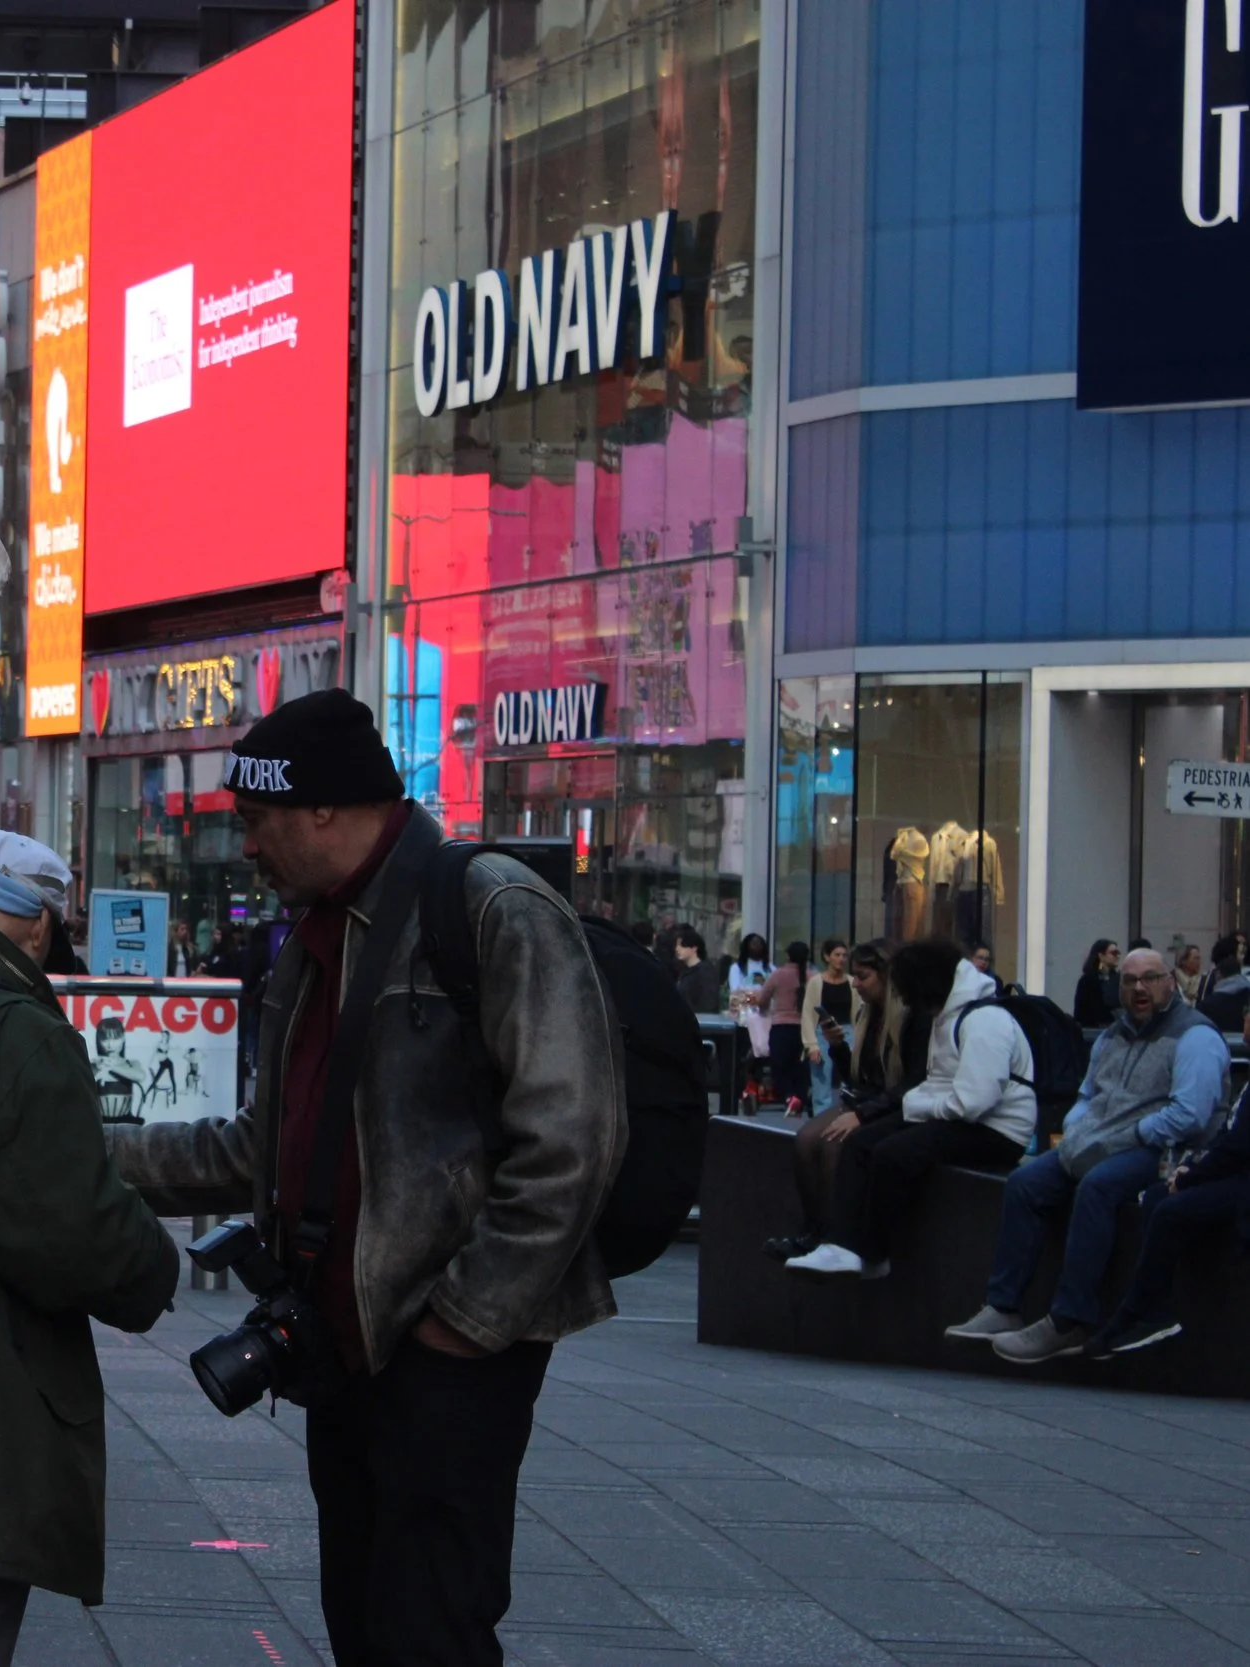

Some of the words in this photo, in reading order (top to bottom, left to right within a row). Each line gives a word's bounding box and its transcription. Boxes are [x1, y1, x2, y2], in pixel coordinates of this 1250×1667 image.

[413, 268, 511, 417] OLD
[516, 209, 677, 391] NAVY
[494, 690, 533, 746] OLD
[537, 683, 597, 743] NAVY
[237, 756, 293, 792] YORK
